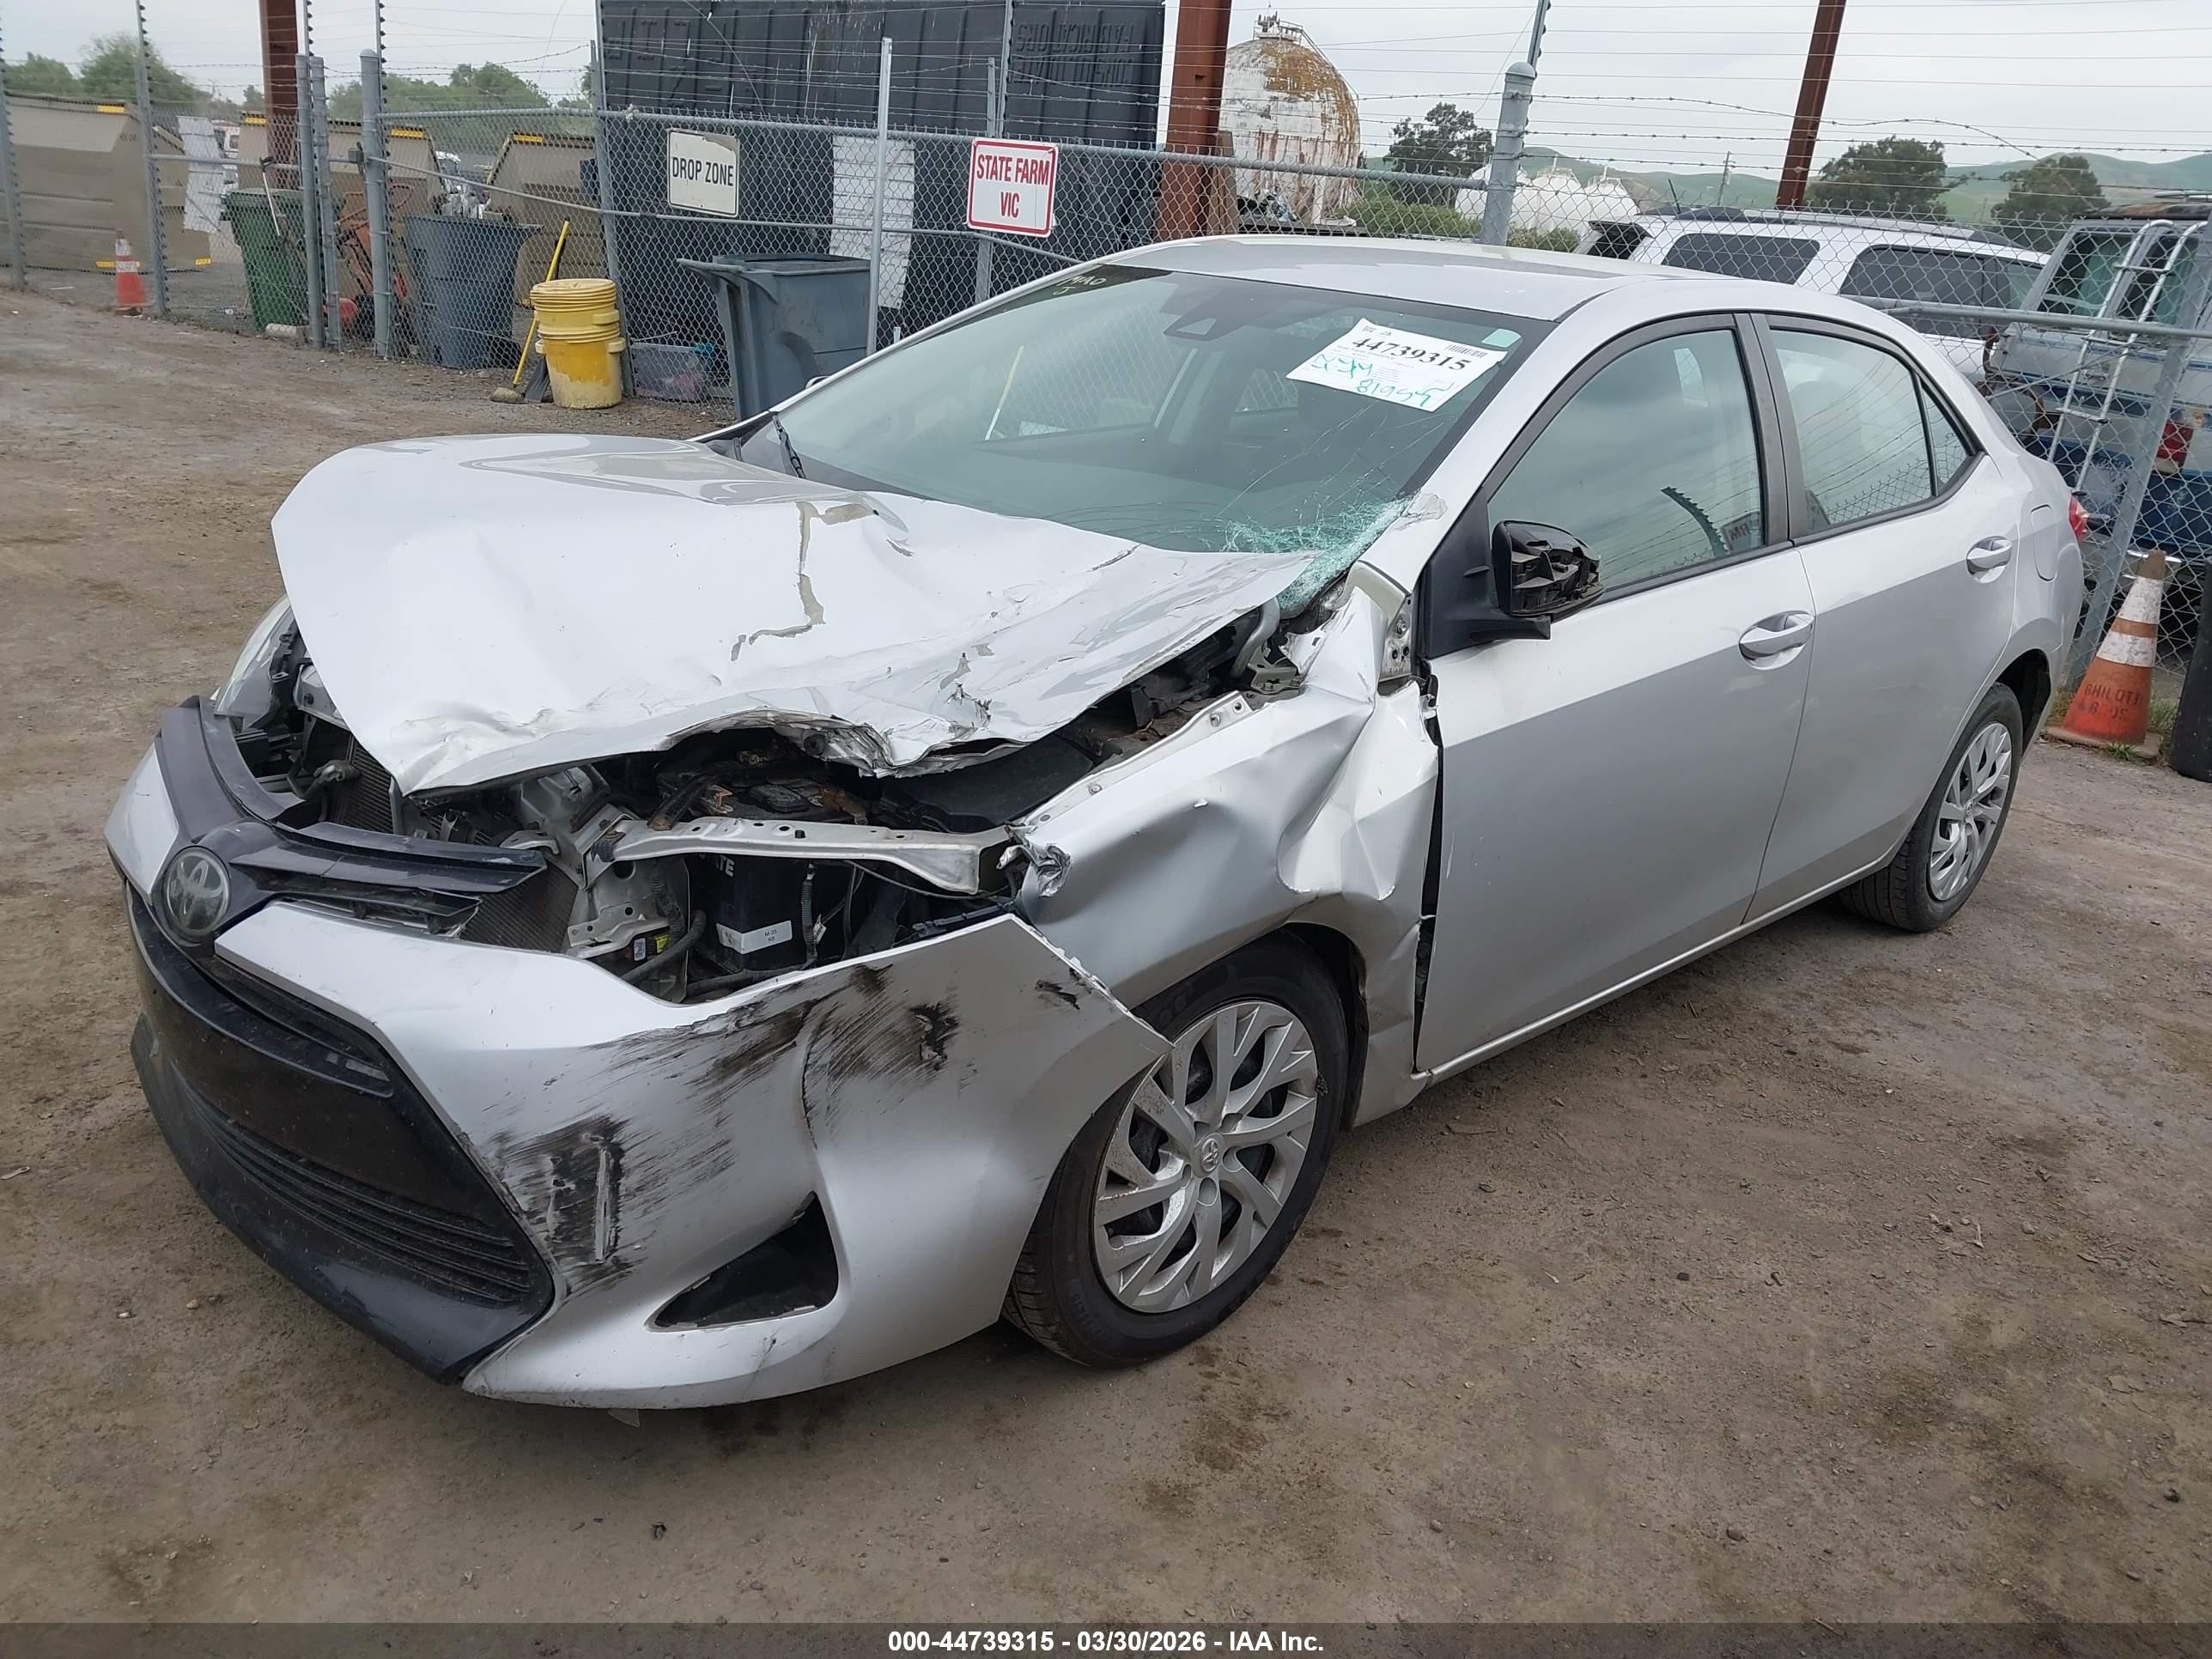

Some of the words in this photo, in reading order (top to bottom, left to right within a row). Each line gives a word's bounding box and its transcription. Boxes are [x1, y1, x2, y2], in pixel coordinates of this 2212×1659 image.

[672, 156, 702, 181] DROP
[705, 161, 734, 186] ZONE
[976, 155, 1012, 182] STATE
[1015, 157, 1050, 185] FARM
[1000, 191, 1020, 218] VIC
[1352, 337, 1472, 370] 44739315
